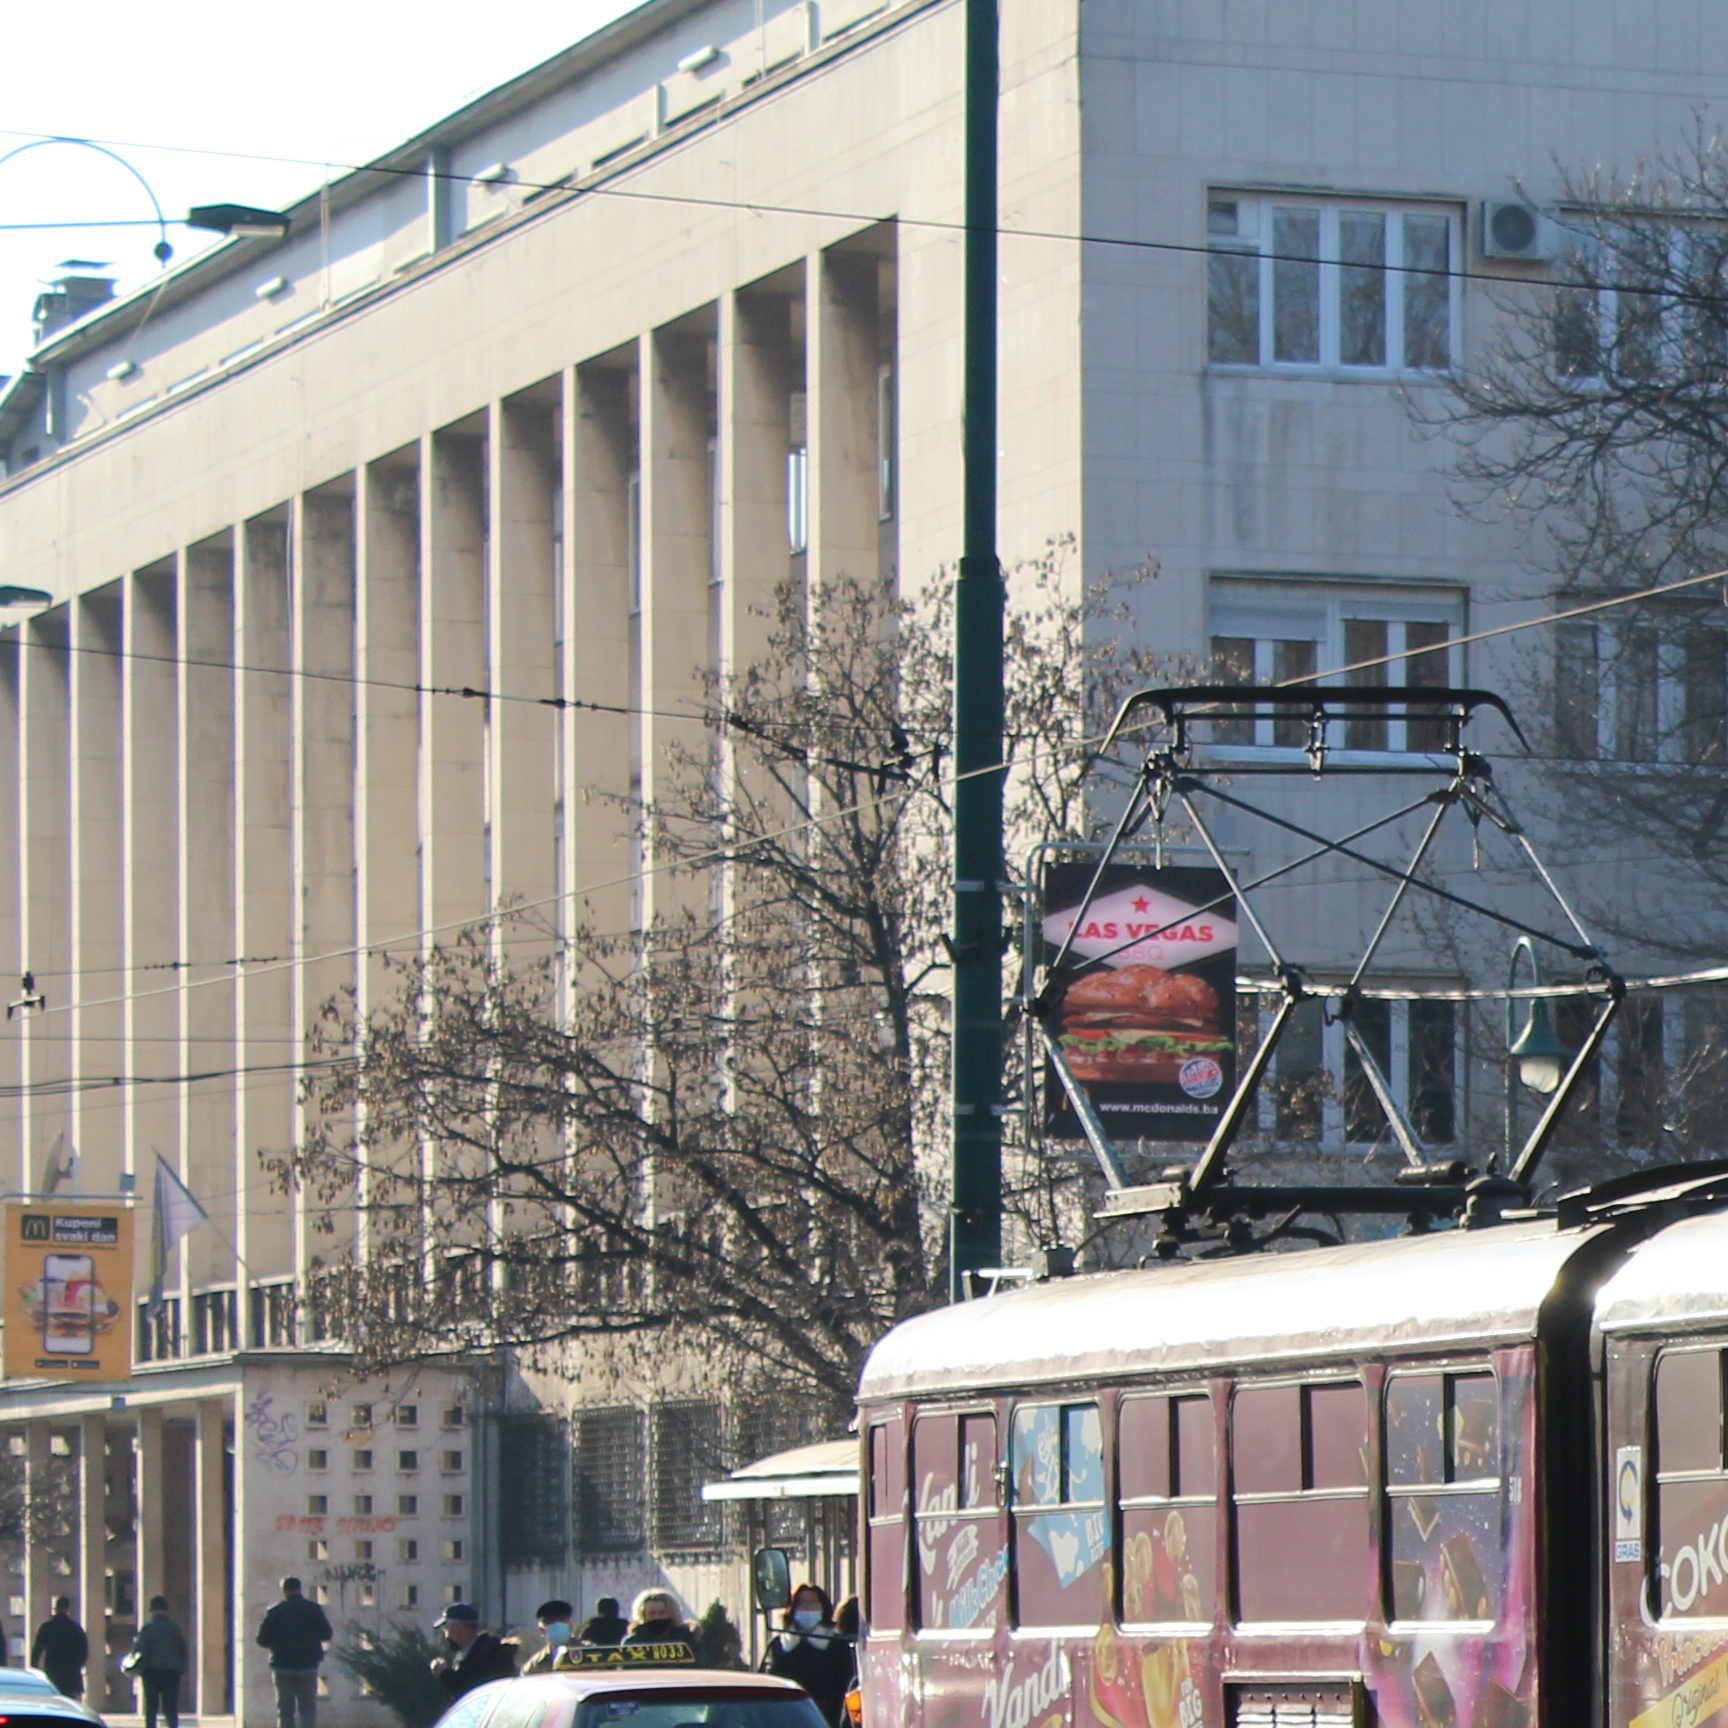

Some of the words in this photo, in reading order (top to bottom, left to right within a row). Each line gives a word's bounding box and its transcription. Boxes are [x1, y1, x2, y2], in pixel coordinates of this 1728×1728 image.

[1126, 923, 1213, 942] VEGAS
[1099, 1102, 1218, 1115] www.mcdonalds.ba
[1616, 1543, 1641, 1559] GRAS
